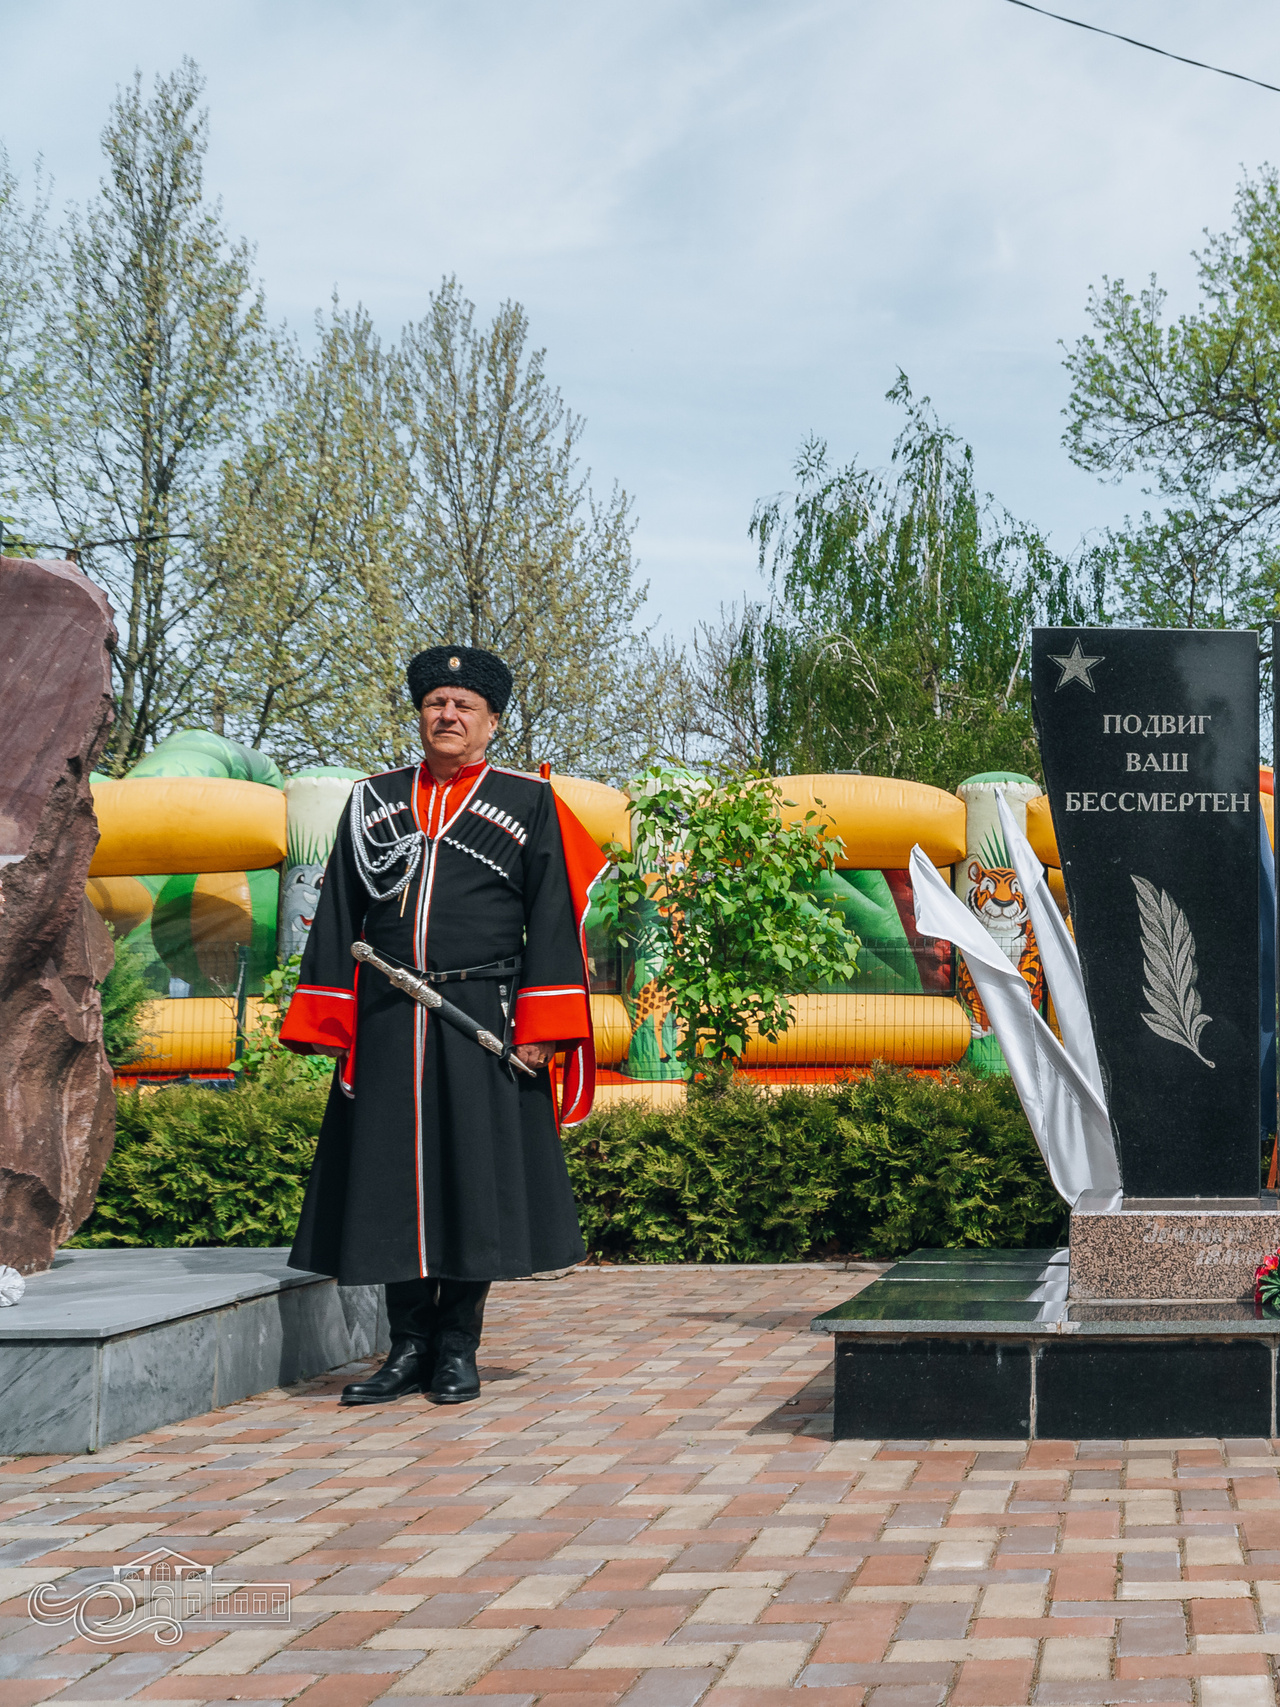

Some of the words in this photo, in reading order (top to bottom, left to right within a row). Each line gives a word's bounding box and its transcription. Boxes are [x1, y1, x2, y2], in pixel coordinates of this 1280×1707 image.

[1103, 714, 1211, 738] ПОДВИГ
[1126, 752, 1189, 772] ВАШ
[1065, 792, 1250, 813] БЕССМЕРТЕН
